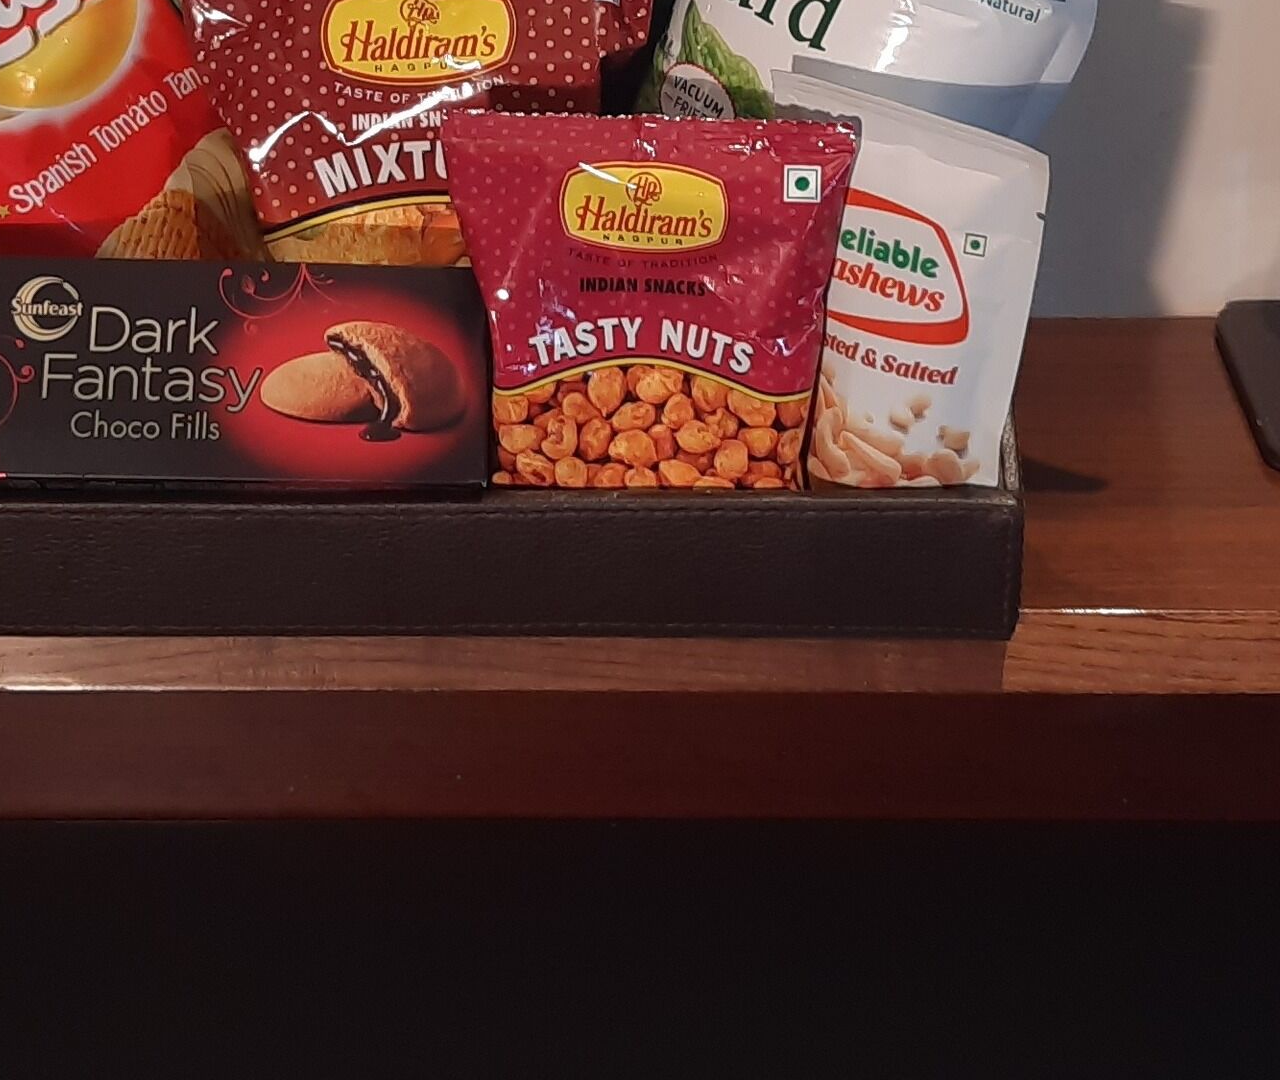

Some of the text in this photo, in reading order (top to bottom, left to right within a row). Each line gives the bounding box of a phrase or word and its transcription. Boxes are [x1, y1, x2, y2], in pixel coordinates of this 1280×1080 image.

[340, 20, 497, 62] Haldiram's
[334, 81, 383, 103] TASTE
[390, 93, 411, 104] OF
[673, 96, 708, 117] FRIE
[674, 76, 724, 118] VACUUM
[9, 66, 204, 214] Spanish Tomato Tan
[575, 195, 713, 238] Haldiram's
[569, 248, 611, 267] TASTE
[643, 254, 718, 269] TRADITION
[840, 227, 939, 279] eliable
[11, 296, 84, 317] Sunfeast
[579, 277, 706, 297] INDIAN SNACKS
[832, 258, 945, 313] ashews
[89, 306, 219, 355] Dark
[528, 316, 754, 374] TASTY NUTS
[823, 333, 959, 386] sted & Salted
[41, 352, 262, 412] Fantasy
[70, 409, 220, 441] Choco Fills
